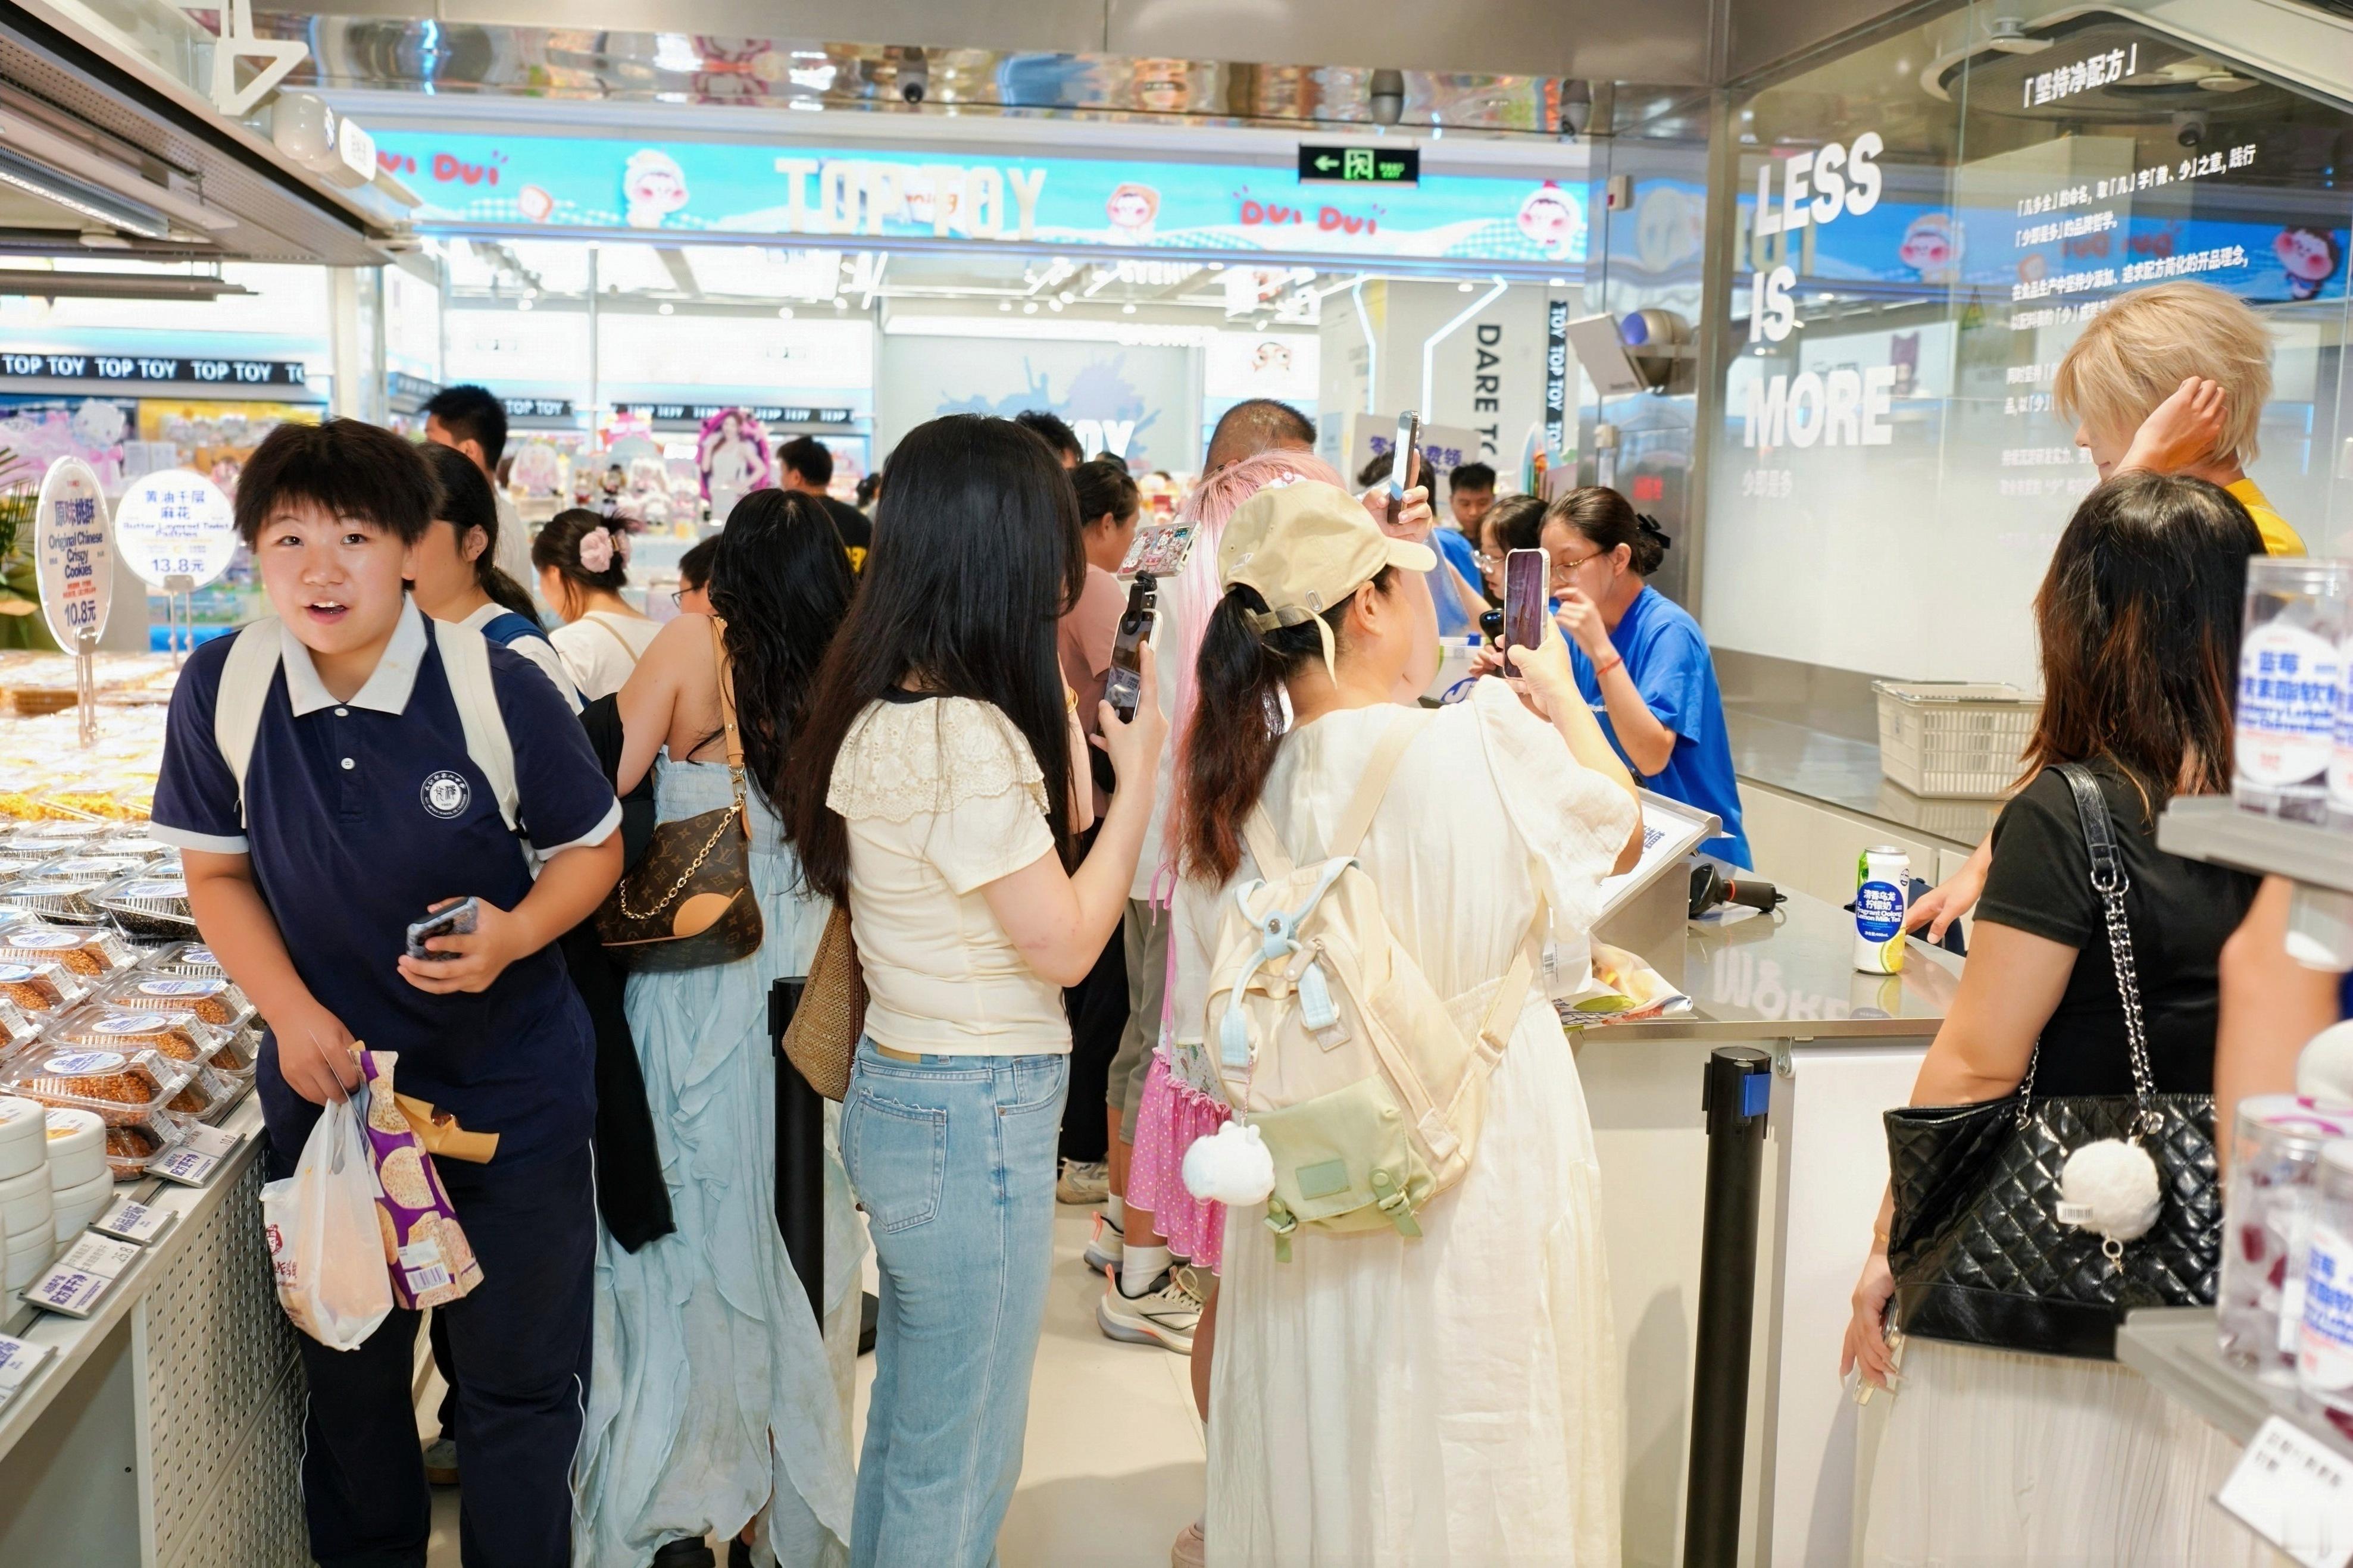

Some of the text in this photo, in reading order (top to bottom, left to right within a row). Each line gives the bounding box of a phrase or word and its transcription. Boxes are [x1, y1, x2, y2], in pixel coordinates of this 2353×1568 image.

[1755, 131, 1884, 238] LESS
[774, 157, 1048, 241] TOP TOY
[1749, 265, 1797, 343] IS
[1549, 306, 1567, 339] TOY
[3, 354, 305, 383] TOP TOY TOP TOY TOP TOY TO
[1474, 324, 1502, 412] DARE
[1548, 344, 1565, 377] TOP
[505, 400, 533, 415] TOP
[536, 400, 563, 416] TOY
[1547, 379, 1564, 412] TOY
[1743, 365, 1896, 448] MORE
[1066, 418, 1136, 463] OY
[145, 490, 205, 504] 黄油千层
[161, 506, 191, 519] 麻花
[48, 530, 103, 552] Original Chinese
[67, 547, 89, 565] Crispy
[152, 559, 205, 572] 13.8元
[65, 562, 92, 579] Cookies
[64, 600, 96, 627] 10.8元
[1863, 889, 1896, 902] 清香乌龙
[1857, 912, 1875, 922] Lemon
[1881, 910, 1902, 918] Oolong
